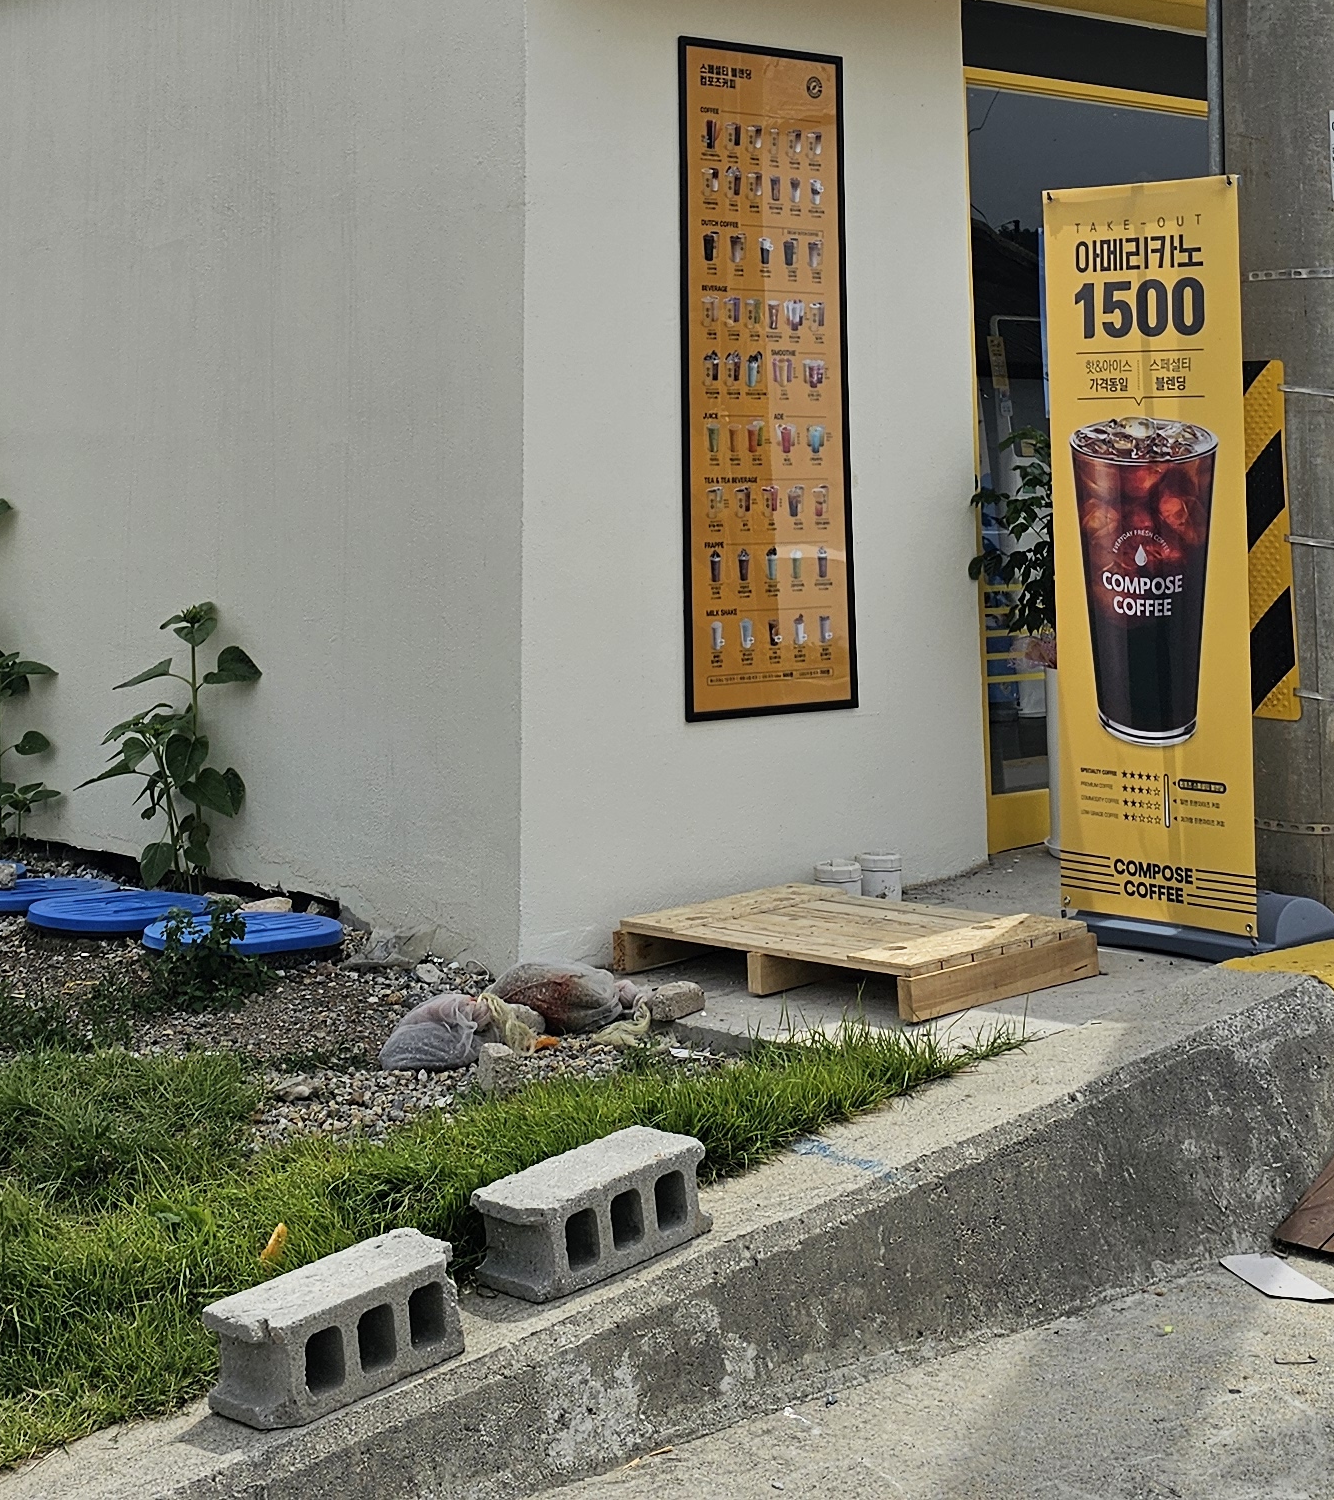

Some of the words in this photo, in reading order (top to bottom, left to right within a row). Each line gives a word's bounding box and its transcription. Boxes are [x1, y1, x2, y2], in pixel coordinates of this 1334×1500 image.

[700, 106, 720, 115] COFFEE
[701, 219, 719, 228] DUTCH
[720, 220, 739, 229] COFFEE
[1075, 214, 1202, 234] TAKE-OUT
[1075, 234, 1204, 274] 아메리카노
[701, 284, 728, 293] BEVERAGE
[1074, 276, 1205, 339] 1500
[1085, 359, 1133, 375] 핫&아이스
[1149, 357, 1192, 373] 스페셜티
[1089, 377, 1129, 392] 가격동일
[1155, 375, 1186, 391] 블렌딩
[704, 541, 725, 549] FRAPPE
[1112, 531, 1133, 553] EVERYDAY
[1134, 529, 1153, 538] FRESH
[1102, 571, 1183, 595] COMPOSE
[1113, 596, 1172, 617] COFFEE
[1114, 858, 1193, 885] COMPOSE
[1124, 880, 1184, 904] COFFEE
